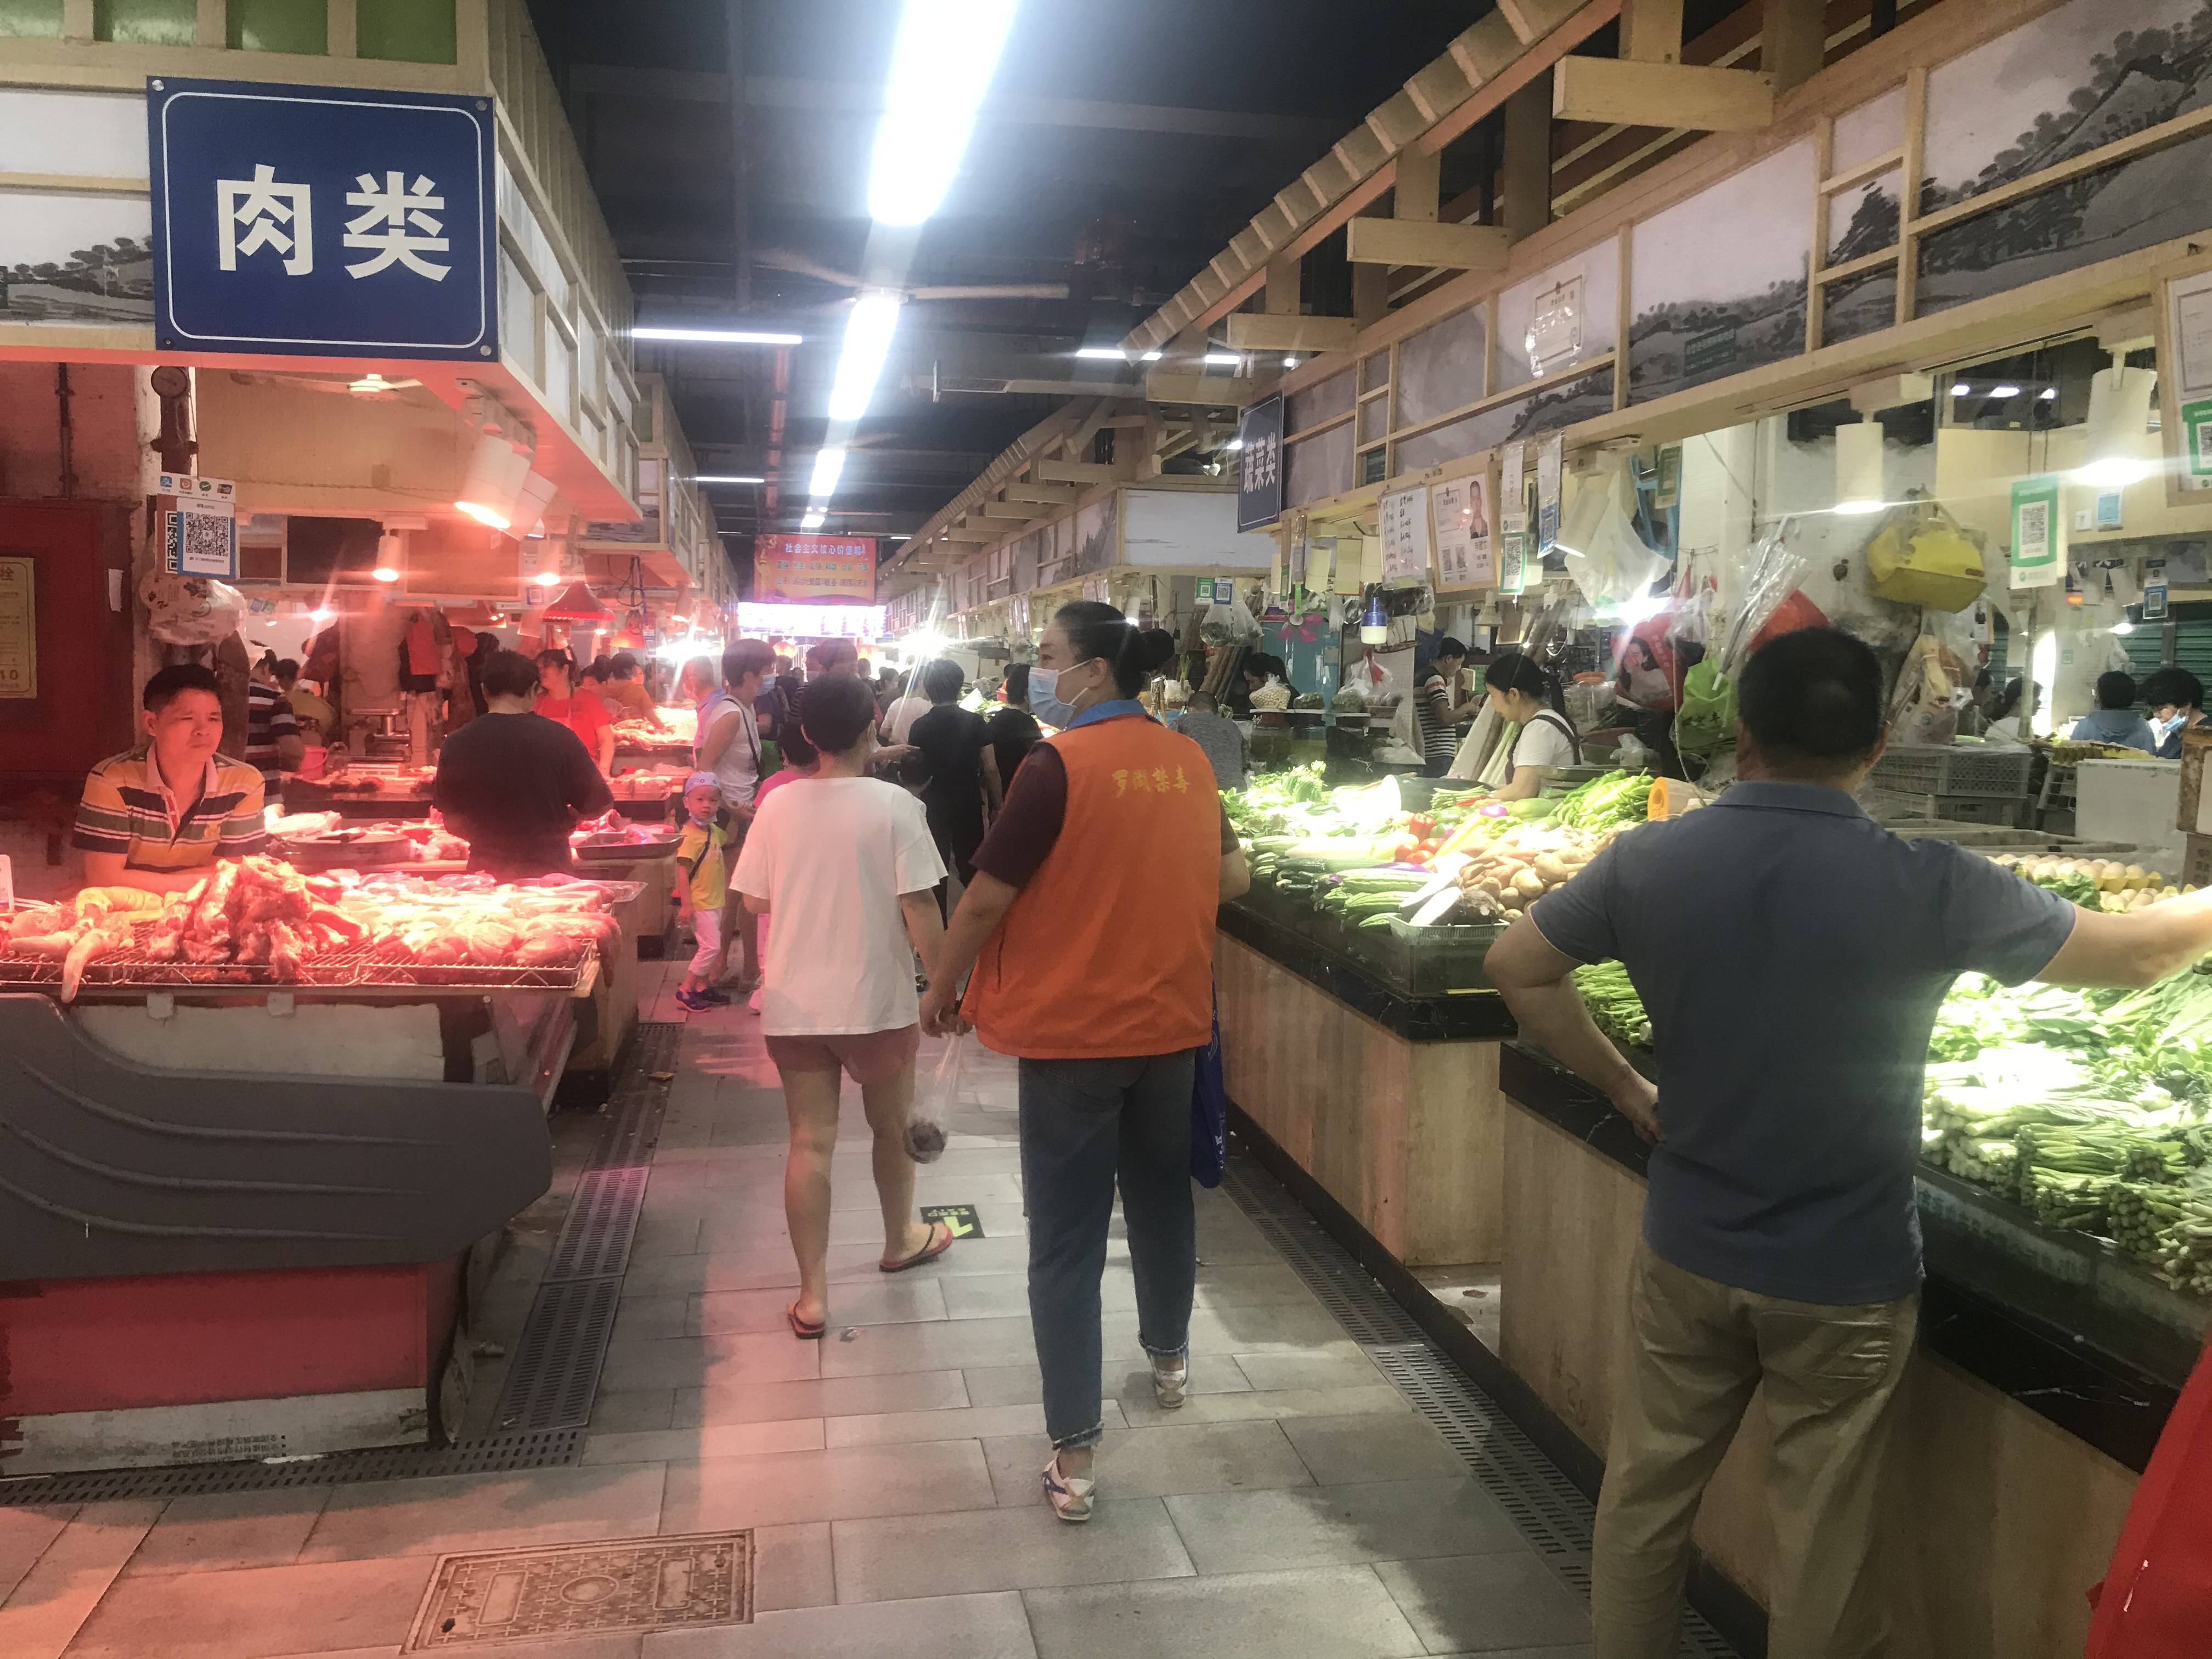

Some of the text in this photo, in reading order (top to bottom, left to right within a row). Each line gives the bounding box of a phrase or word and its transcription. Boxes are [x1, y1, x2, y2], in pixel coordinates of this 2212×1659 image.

[216, 163, 452, 283] 肉类
[1244, 432, 1276, 494] 蔬菜类
[785, 543, 862, 555] 社会主义核心价值观
